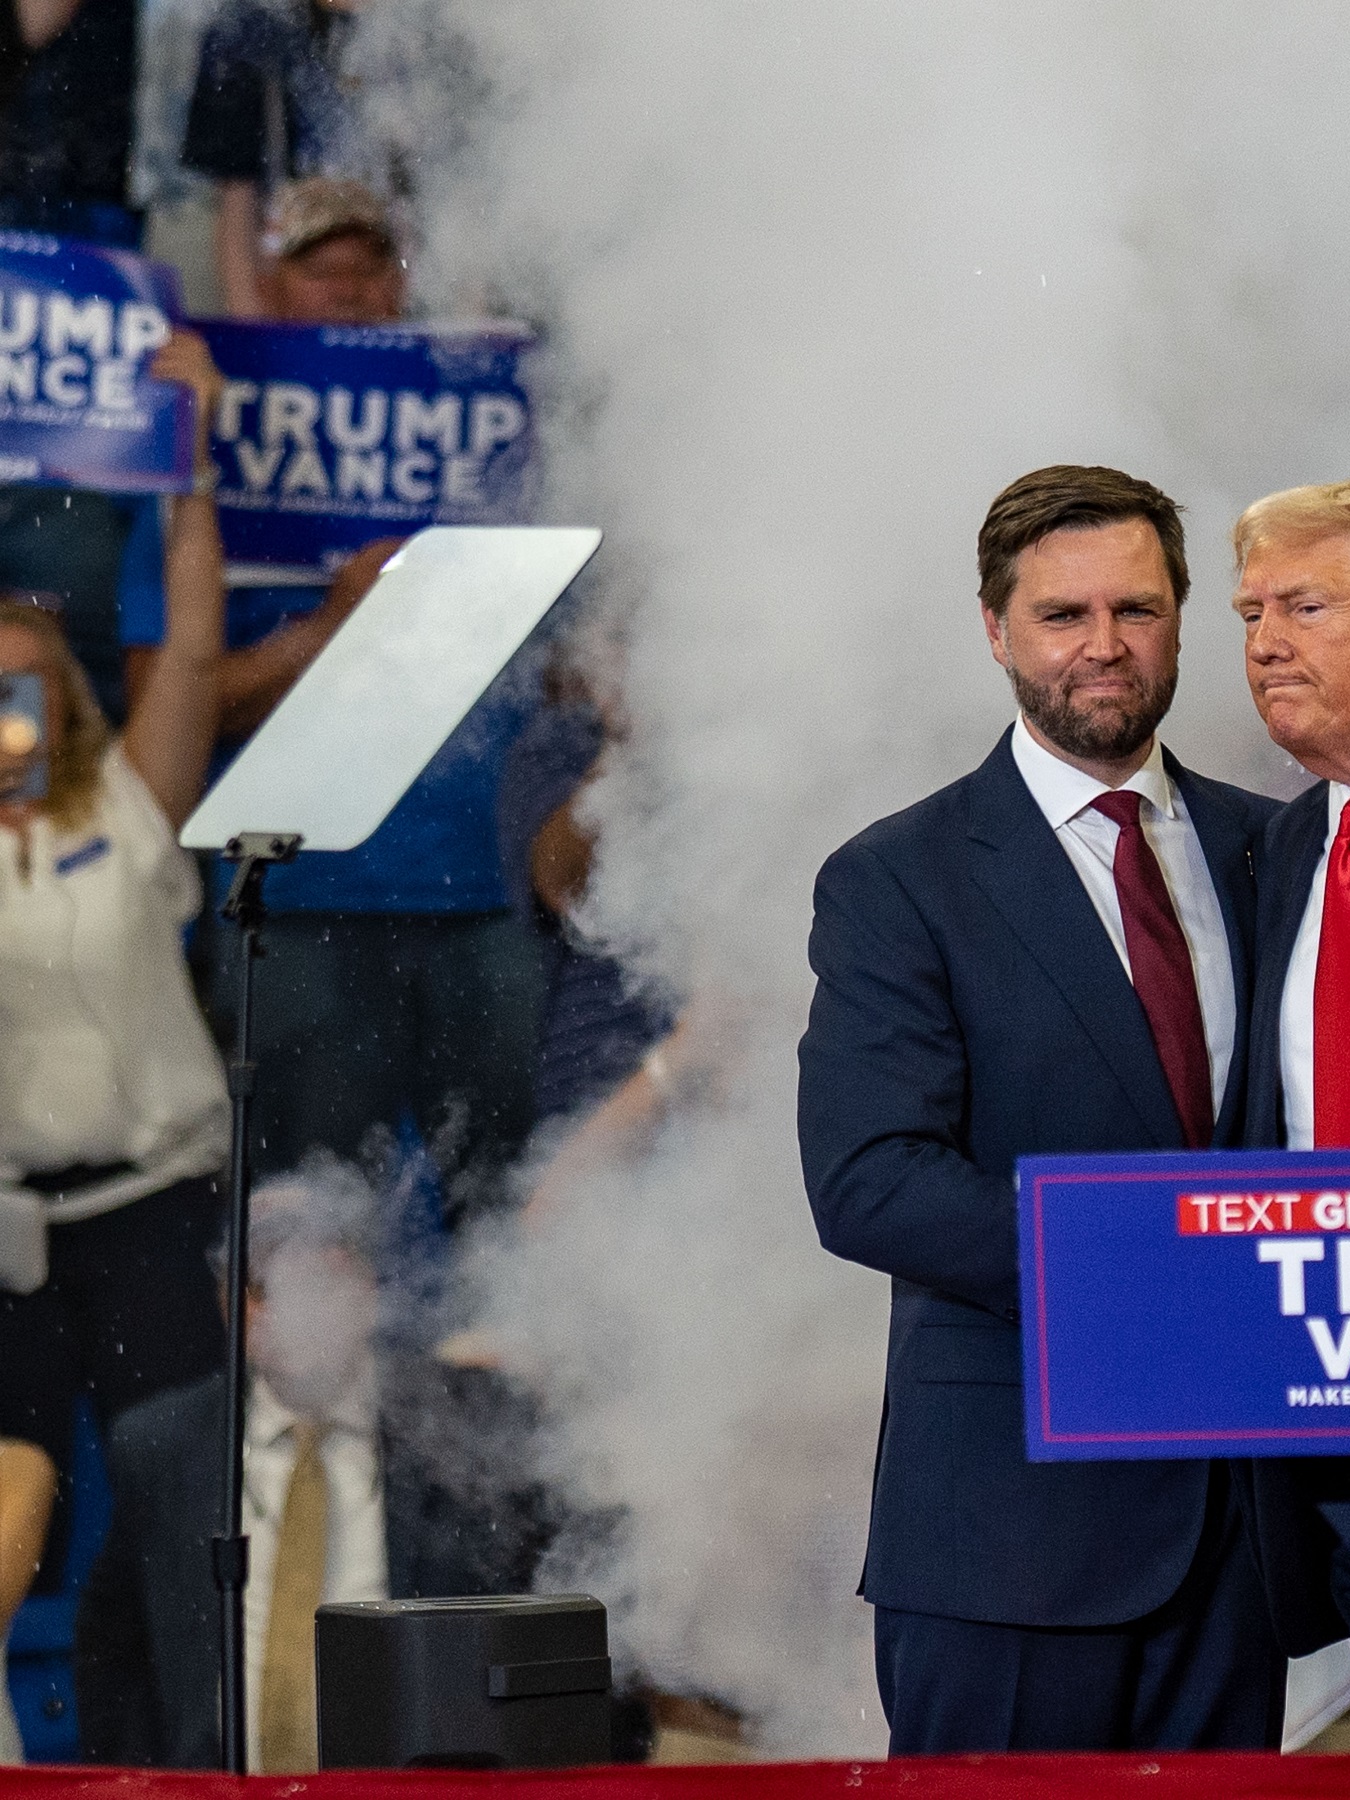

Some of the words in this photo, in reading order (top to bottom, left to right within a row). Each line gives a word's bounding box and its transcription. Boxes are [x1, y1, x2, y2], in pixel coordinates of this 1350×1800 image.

[218, 379, 526, 458] TRUMP
[234, 441, 484, 502] VANCE
[1191, 1193, 1301, 1233] TEXT
